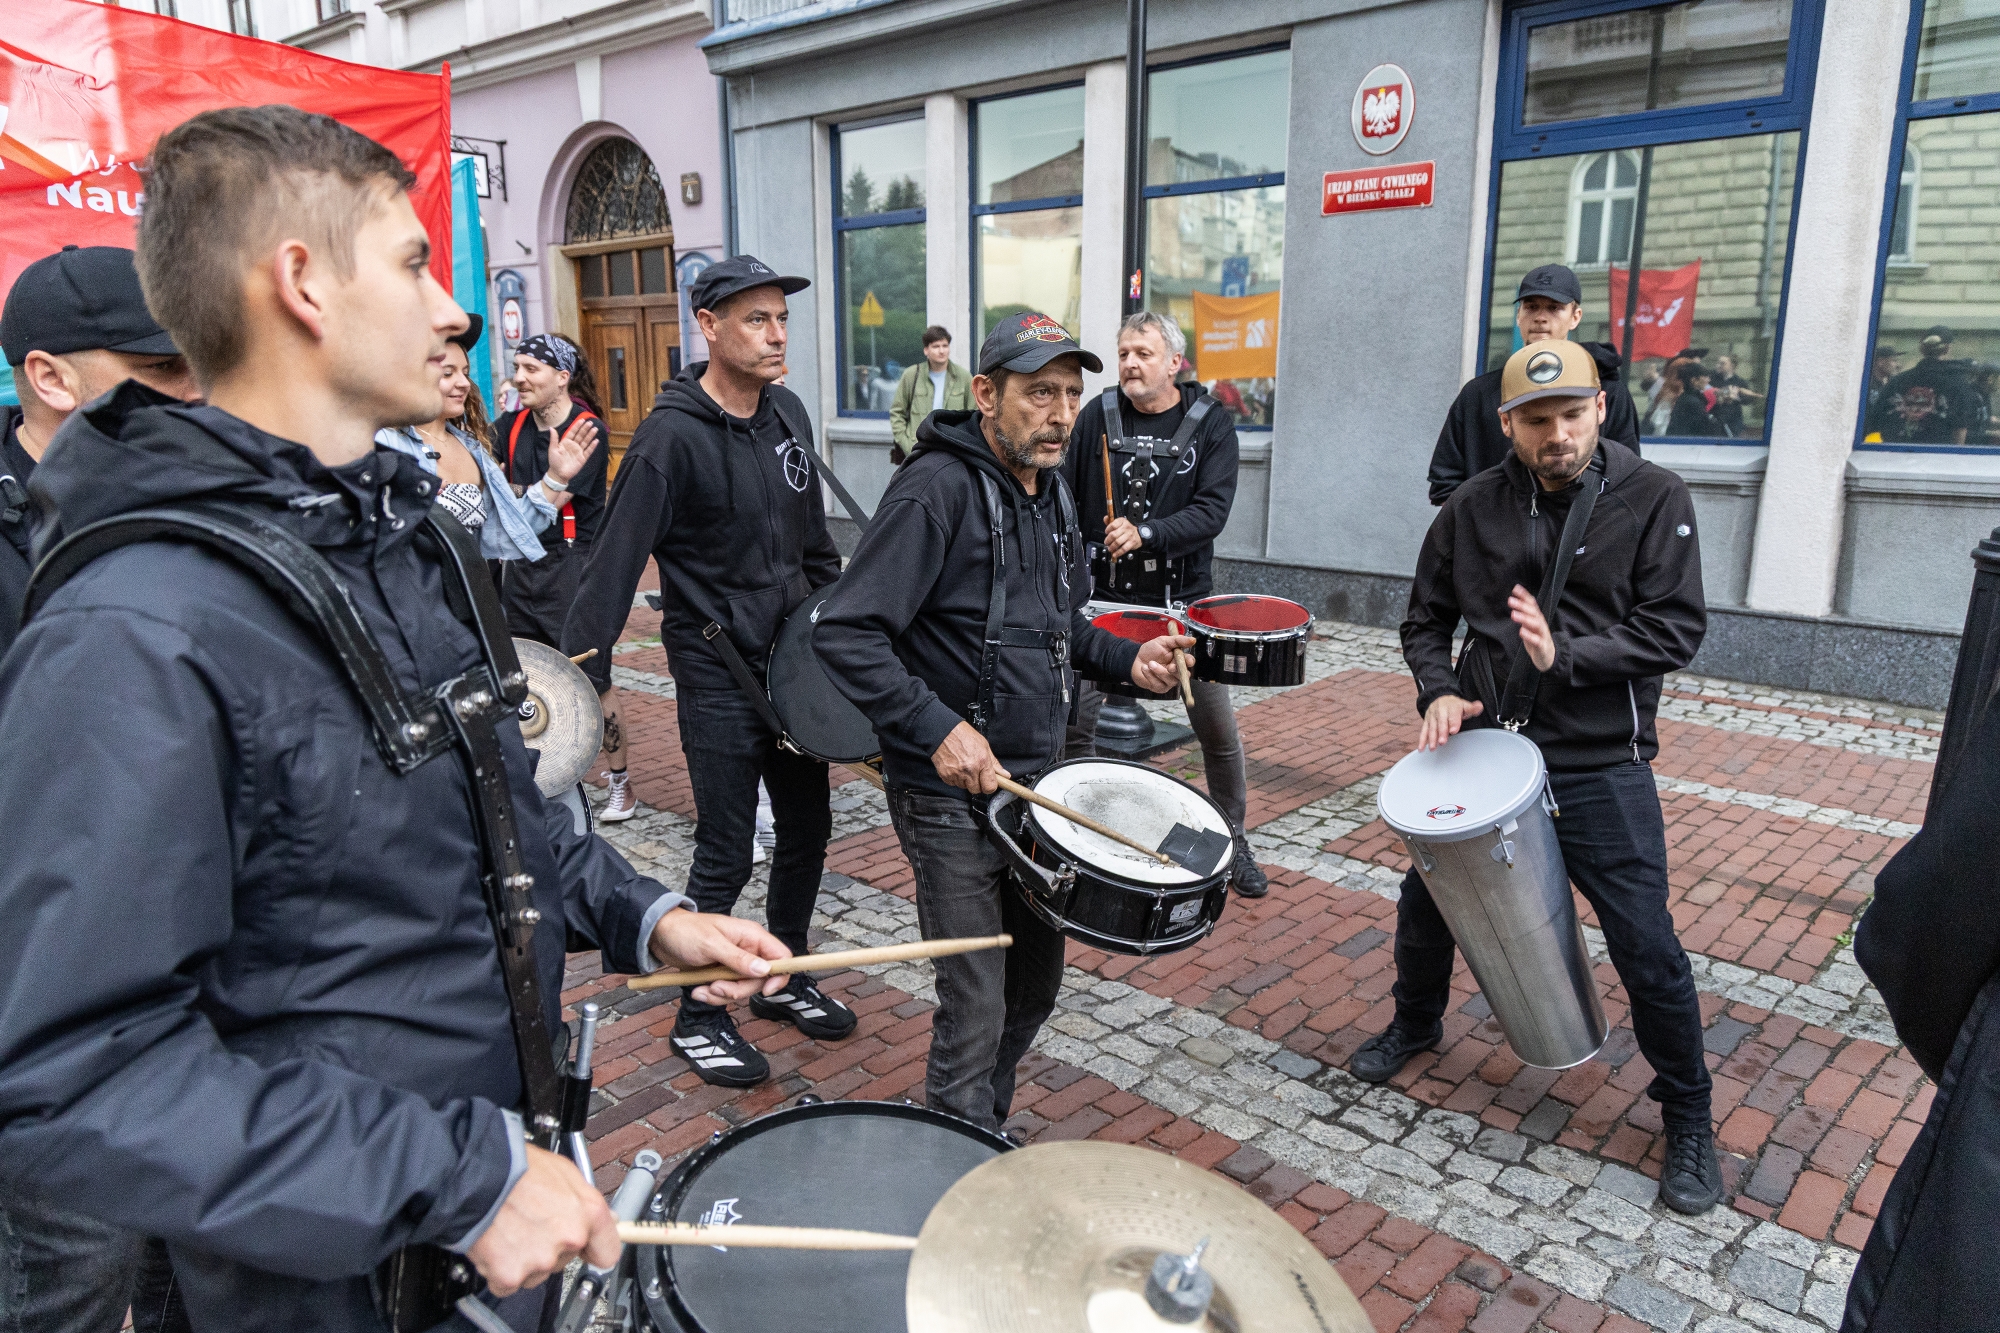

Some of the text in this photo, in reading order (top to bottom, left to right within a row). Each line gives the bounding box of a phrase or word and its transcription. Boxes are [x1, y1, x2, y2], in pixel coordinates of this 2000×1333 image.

[686, 184, 694, 200] 4
[1327, 172, 1428, 195] URZĄD STANU CYWILNEGO
[47, 181, 146, 216] Nau
[1337, 187, 1415, 204] W BIELSKU-BIAŁEJ
